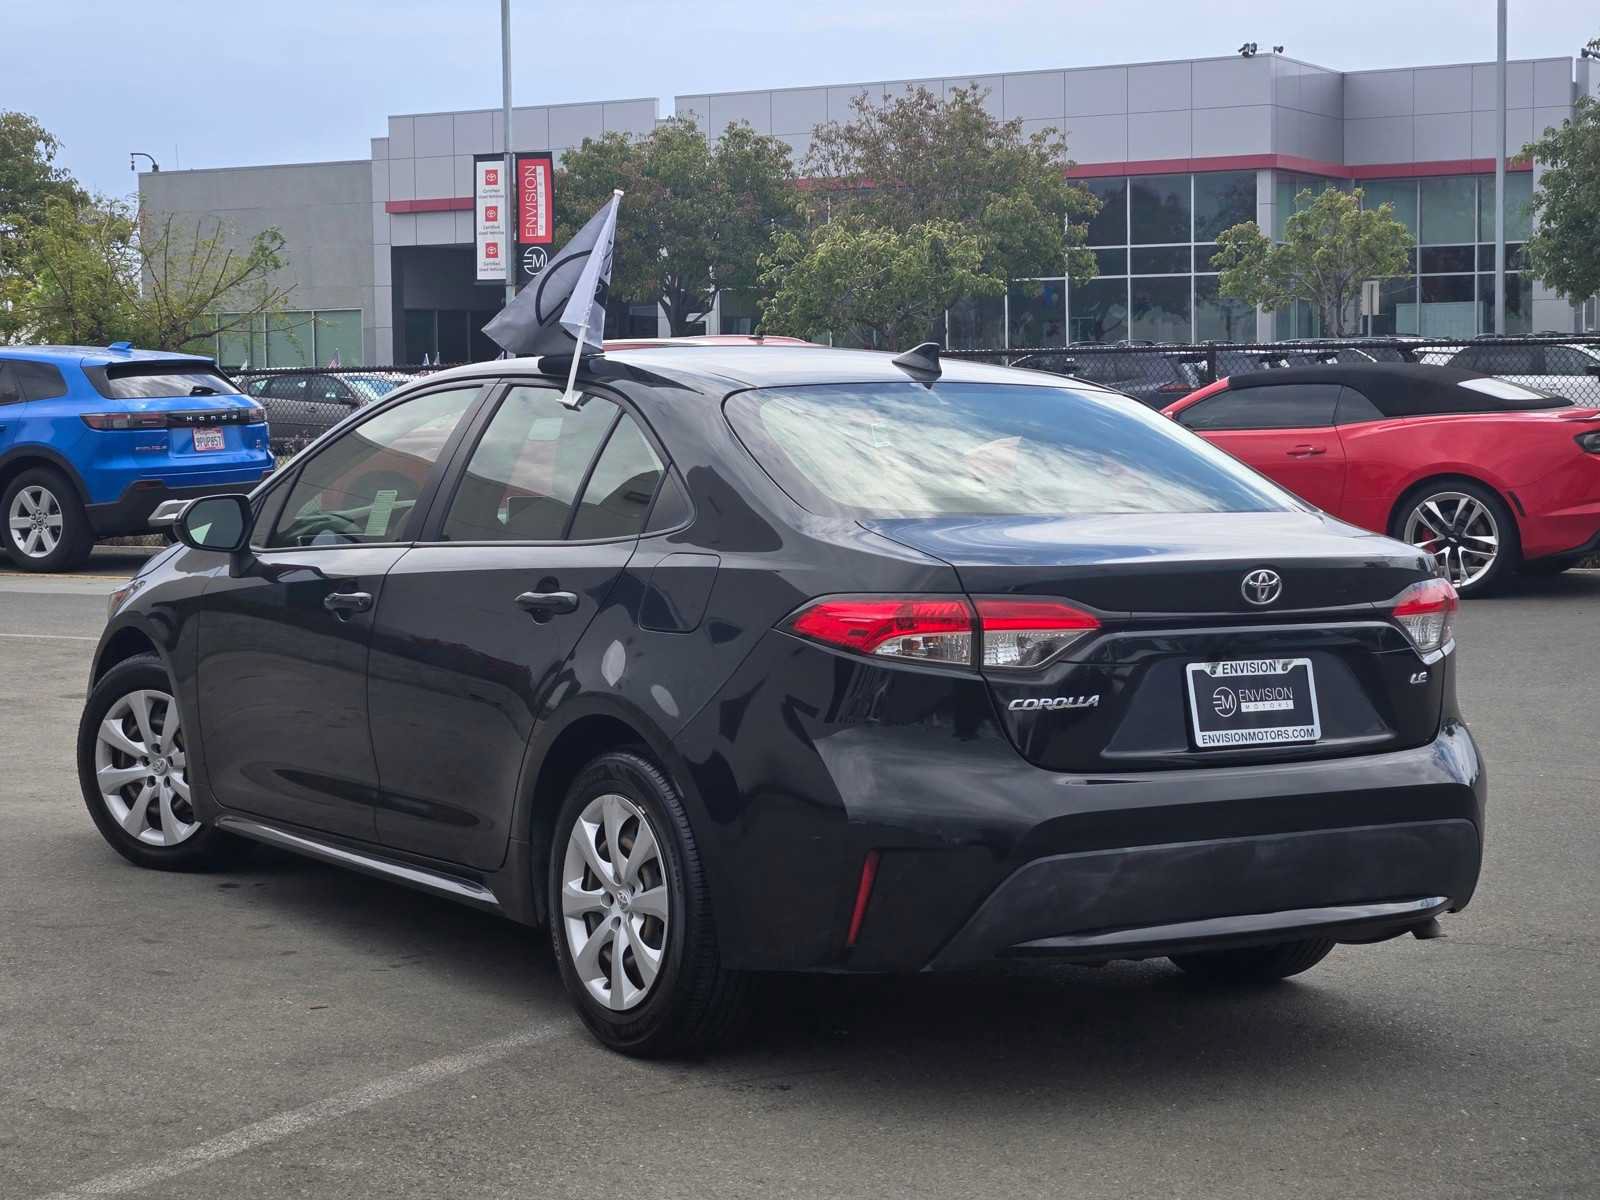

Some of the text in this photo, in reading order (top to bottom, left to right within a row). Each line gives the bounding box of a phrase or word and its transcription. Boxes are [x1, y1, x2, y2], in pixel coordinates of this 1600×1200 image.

[525, 165, 537, 237] ENVISION
[1222, 661, 1277, 675] ENVISION
[1410, 671, 1427, 684] LE
[1008, 694, 1100, 711] COROLLA
[1239, 687, 1293, 703] ENVISION
[1244, 701, 1290, 711] MOTORS
[1202, 728, 1315, 745] ENVISIONMOTORS.COM
